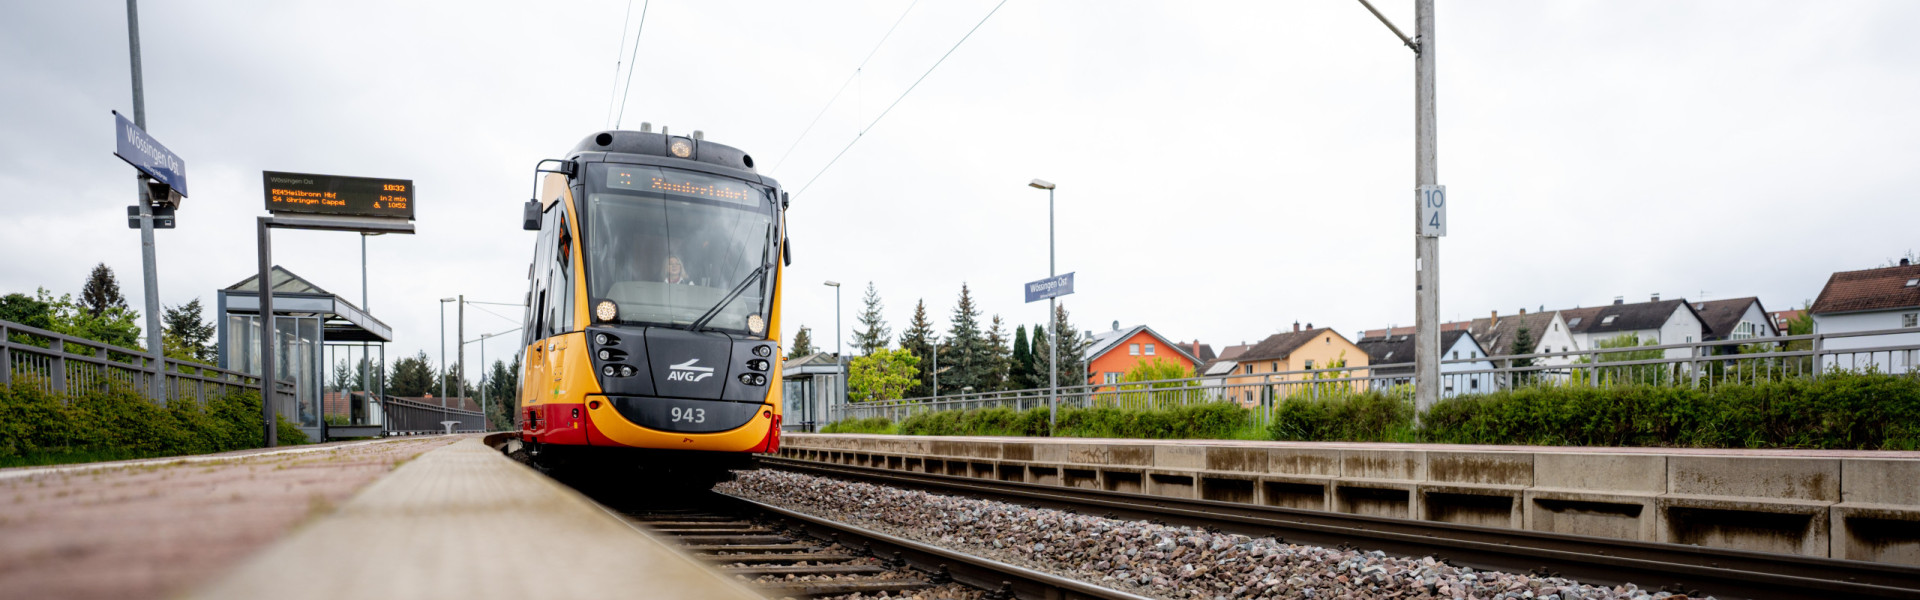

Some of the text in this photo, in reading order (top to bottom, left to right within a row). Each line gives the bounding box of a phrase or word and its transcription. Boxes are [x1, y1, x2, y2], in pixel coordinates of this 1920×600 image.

[126, 124, 167, 165] Wössingen
[167, 155, 179, 176] Ost
[271, 177, 302, 185] Wössingen
[383, 184, 405, 192] 10:32
[321, 198, 346, 206] Cappel
[1425, 189, 1444, 209] 10
[1429, 210, 1440, 230] 4
[1030, 277, 1068, 292] Wössingen Ost
[667, 371, 695, 382] AVG
[671, 406, 706, 423] 943
